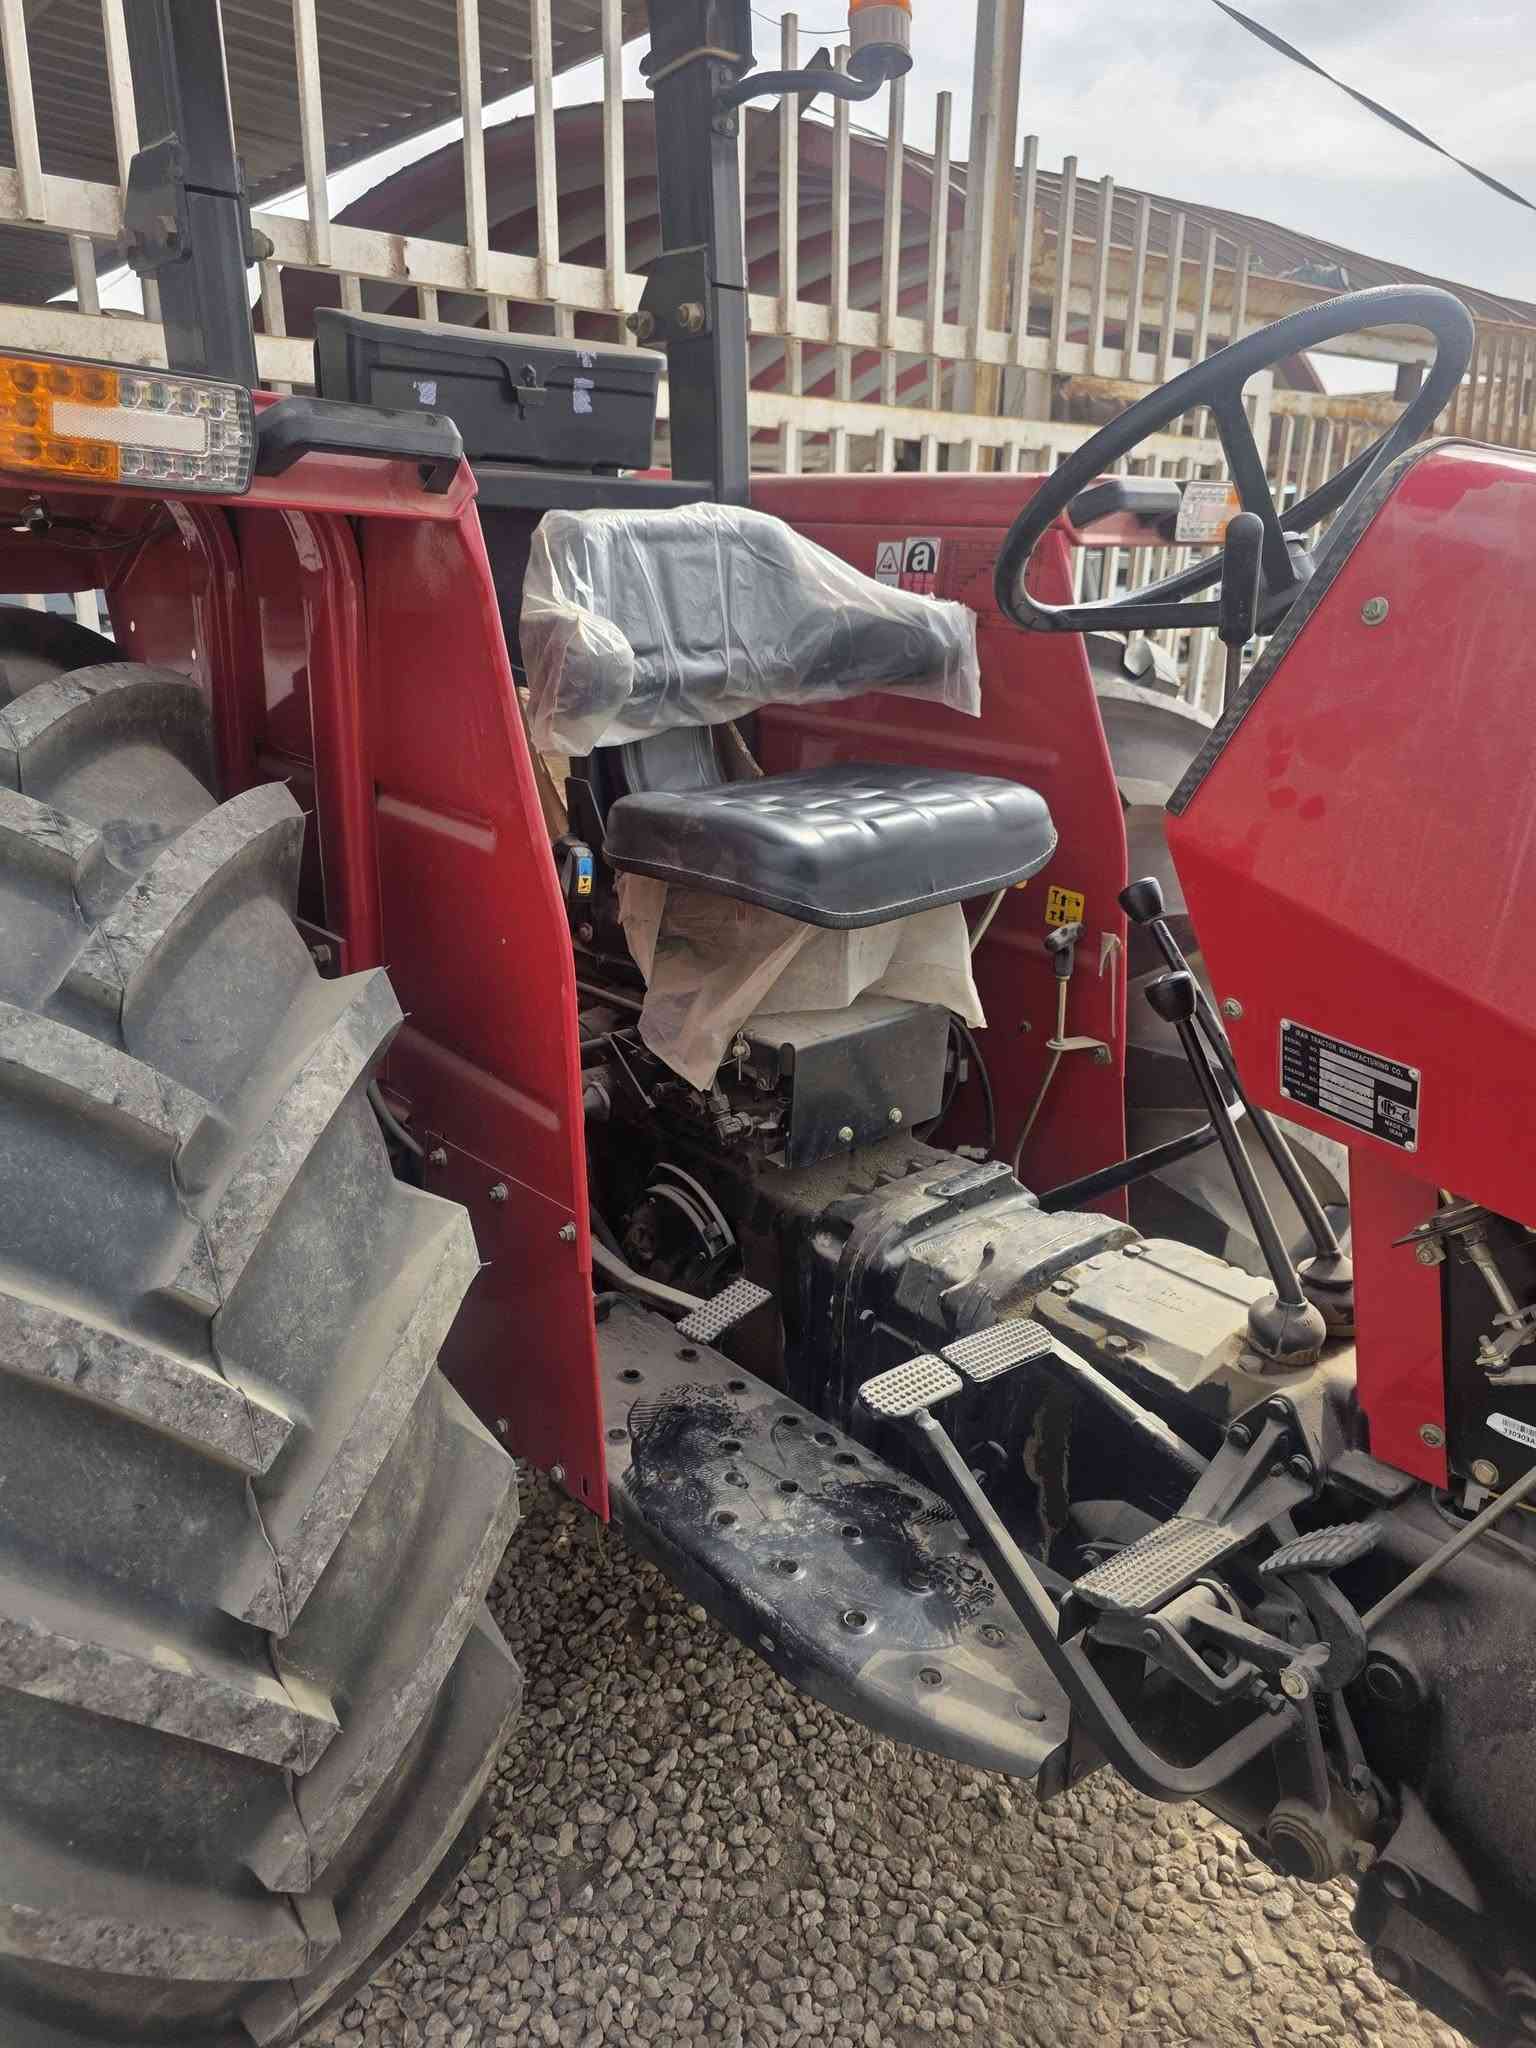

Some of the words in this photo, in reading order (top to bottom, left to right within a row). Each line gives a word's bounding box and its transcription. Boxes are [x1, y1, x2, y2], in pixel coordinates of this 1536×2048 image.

[1310, 1035, 1338, 1051] TRACTOR
[1338, 1046, 1390, 1071] MANUFACTURING
[1391, 1067, 1404, 1078] CO.
